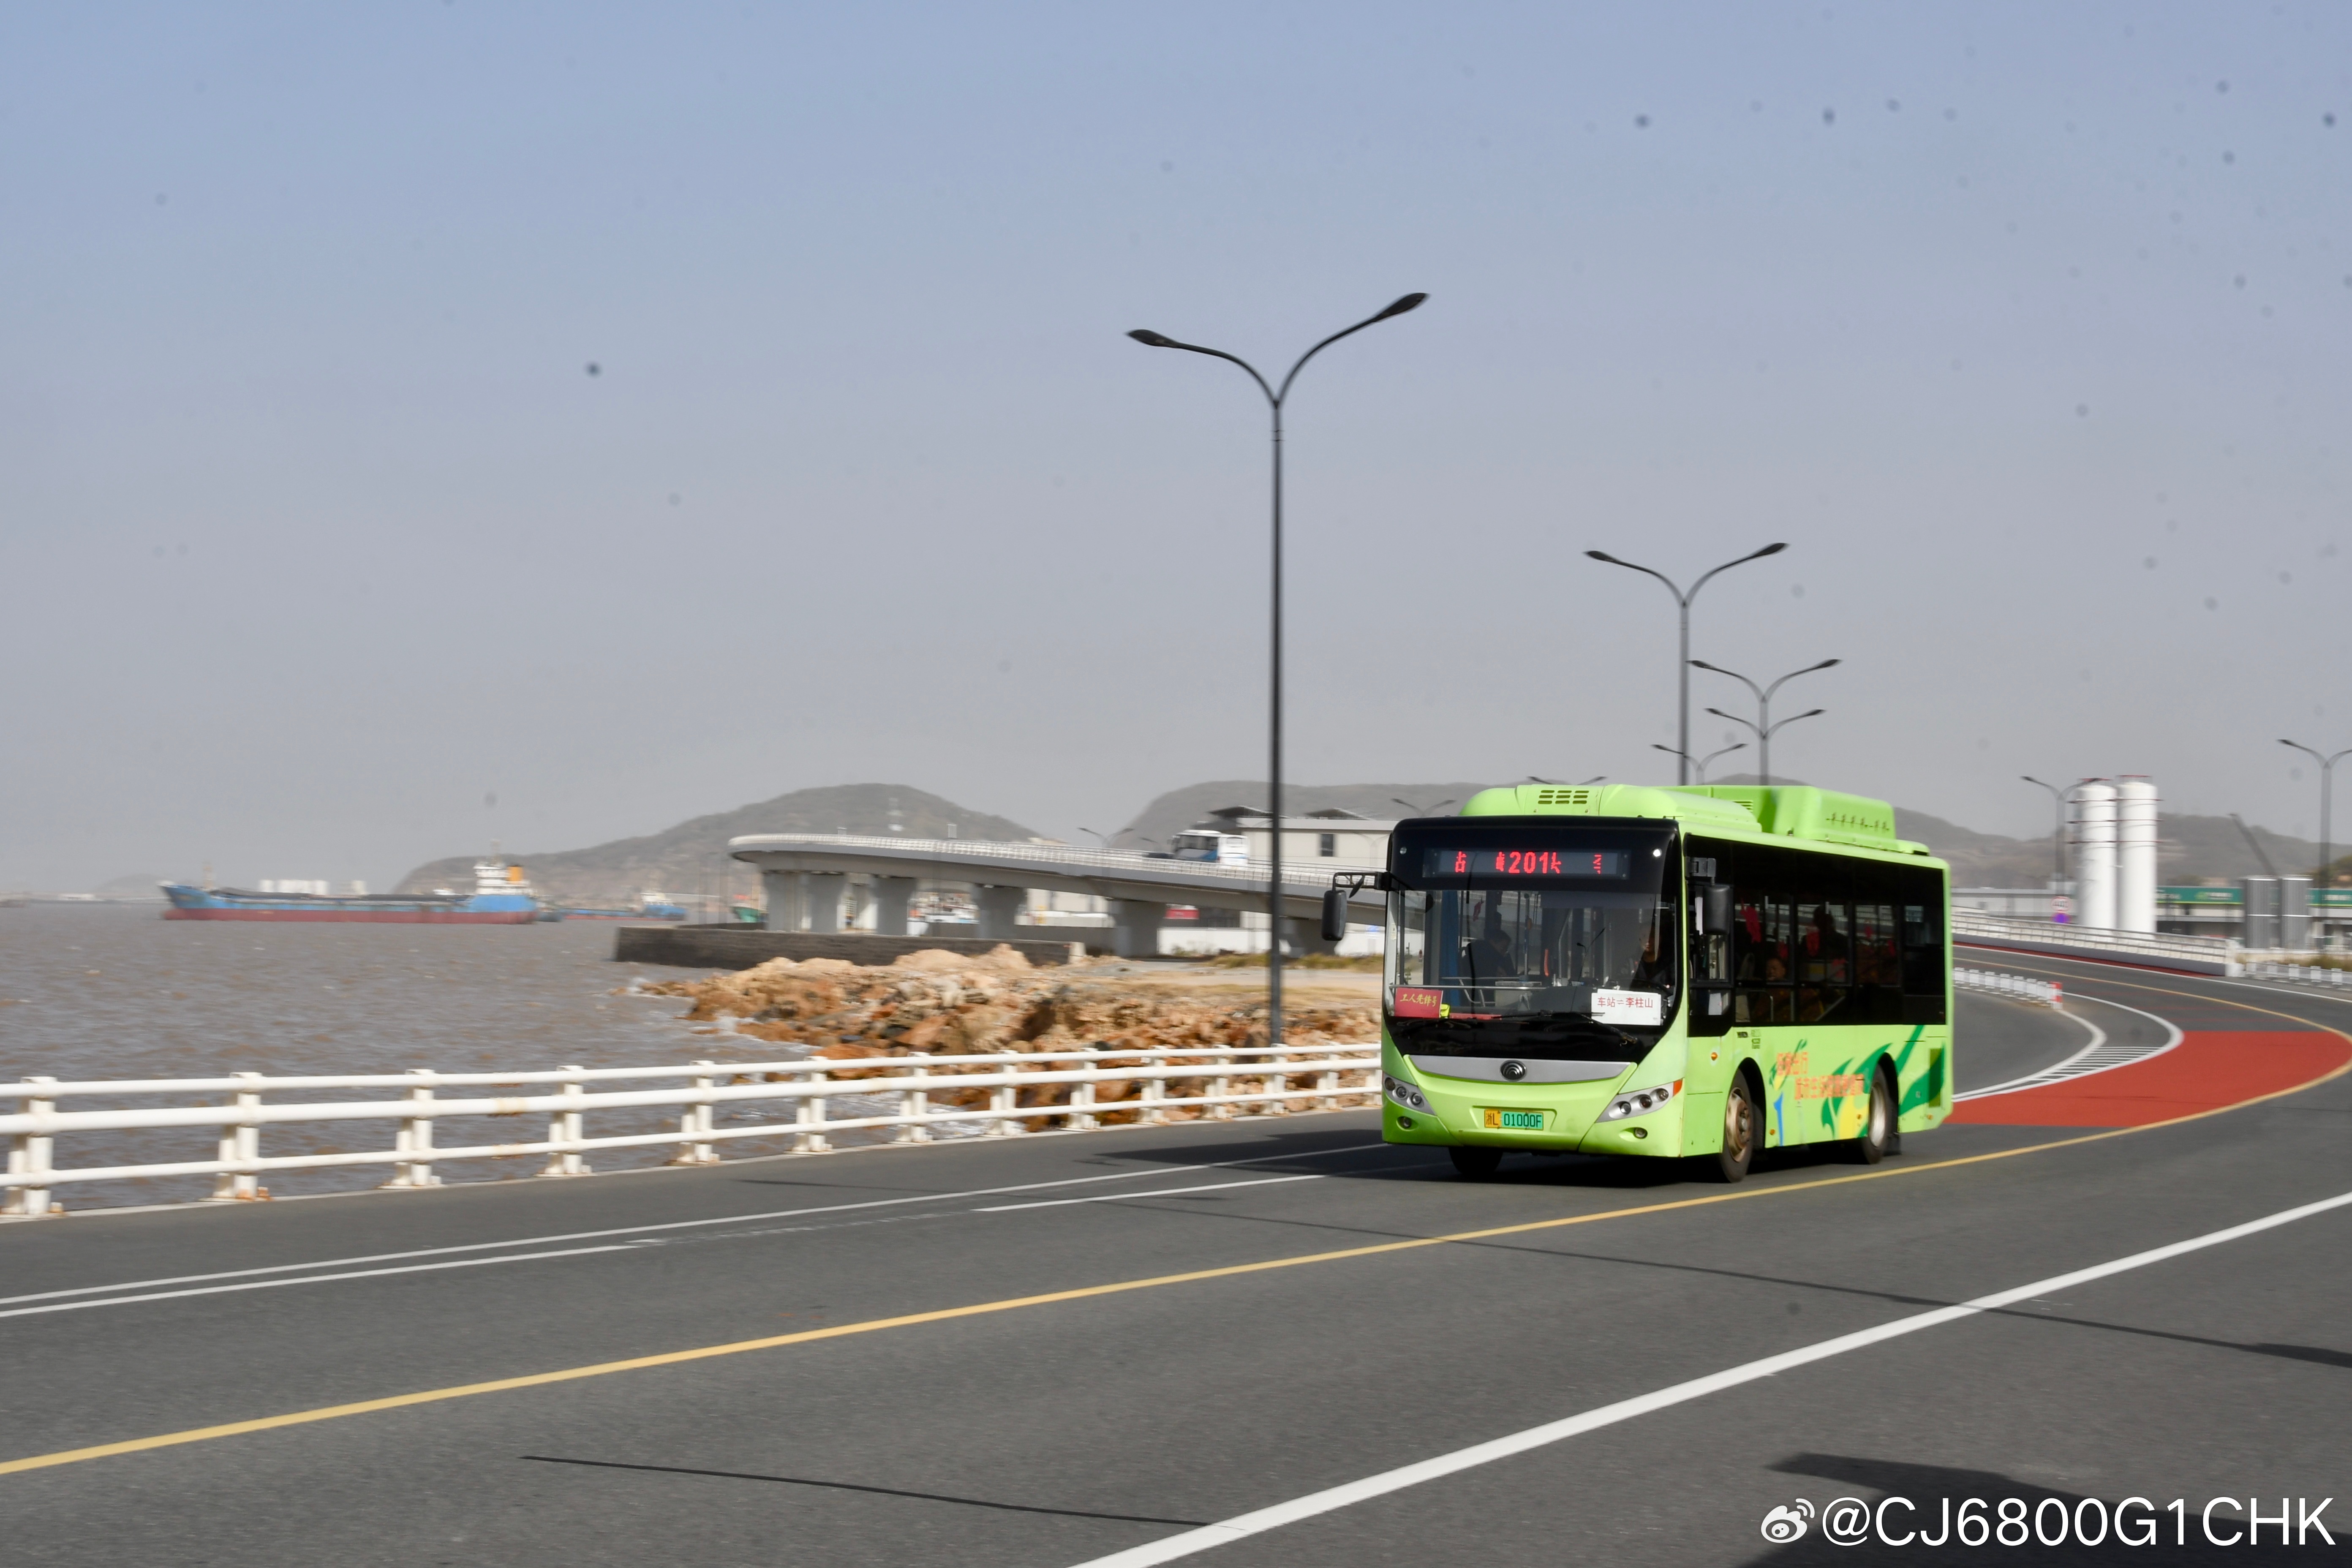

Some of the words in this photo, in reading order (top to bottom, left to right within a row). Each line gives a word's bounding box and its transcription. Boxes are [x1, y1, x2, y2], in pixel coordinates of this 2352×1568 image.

[1400, 993, 1437, 1007] 工人先锋号
